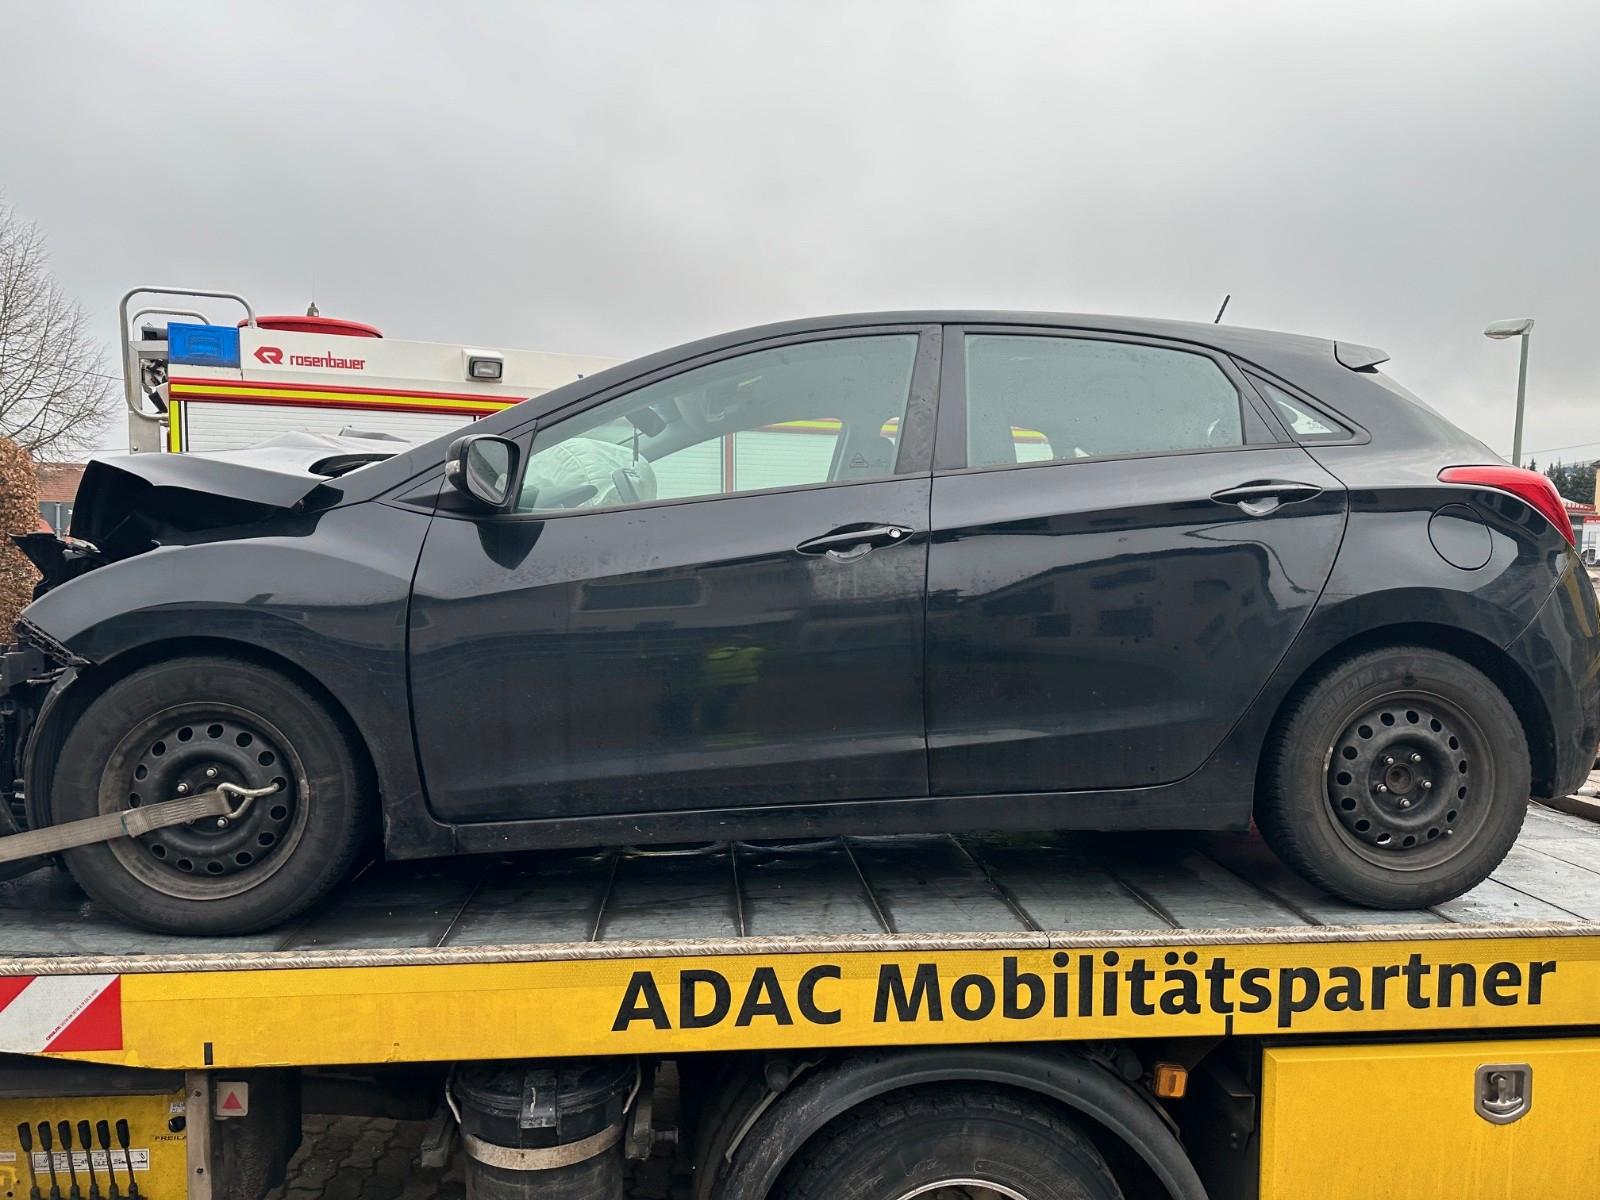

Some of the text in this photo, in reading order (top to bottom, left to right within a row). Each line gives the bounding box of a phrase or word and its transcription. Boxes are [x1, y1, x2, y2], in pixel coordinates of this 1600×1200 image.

[290, 350, 365, 370] rosenbauer
[611, 951, 1557, 1032] ADAC Mobilitätspartner
